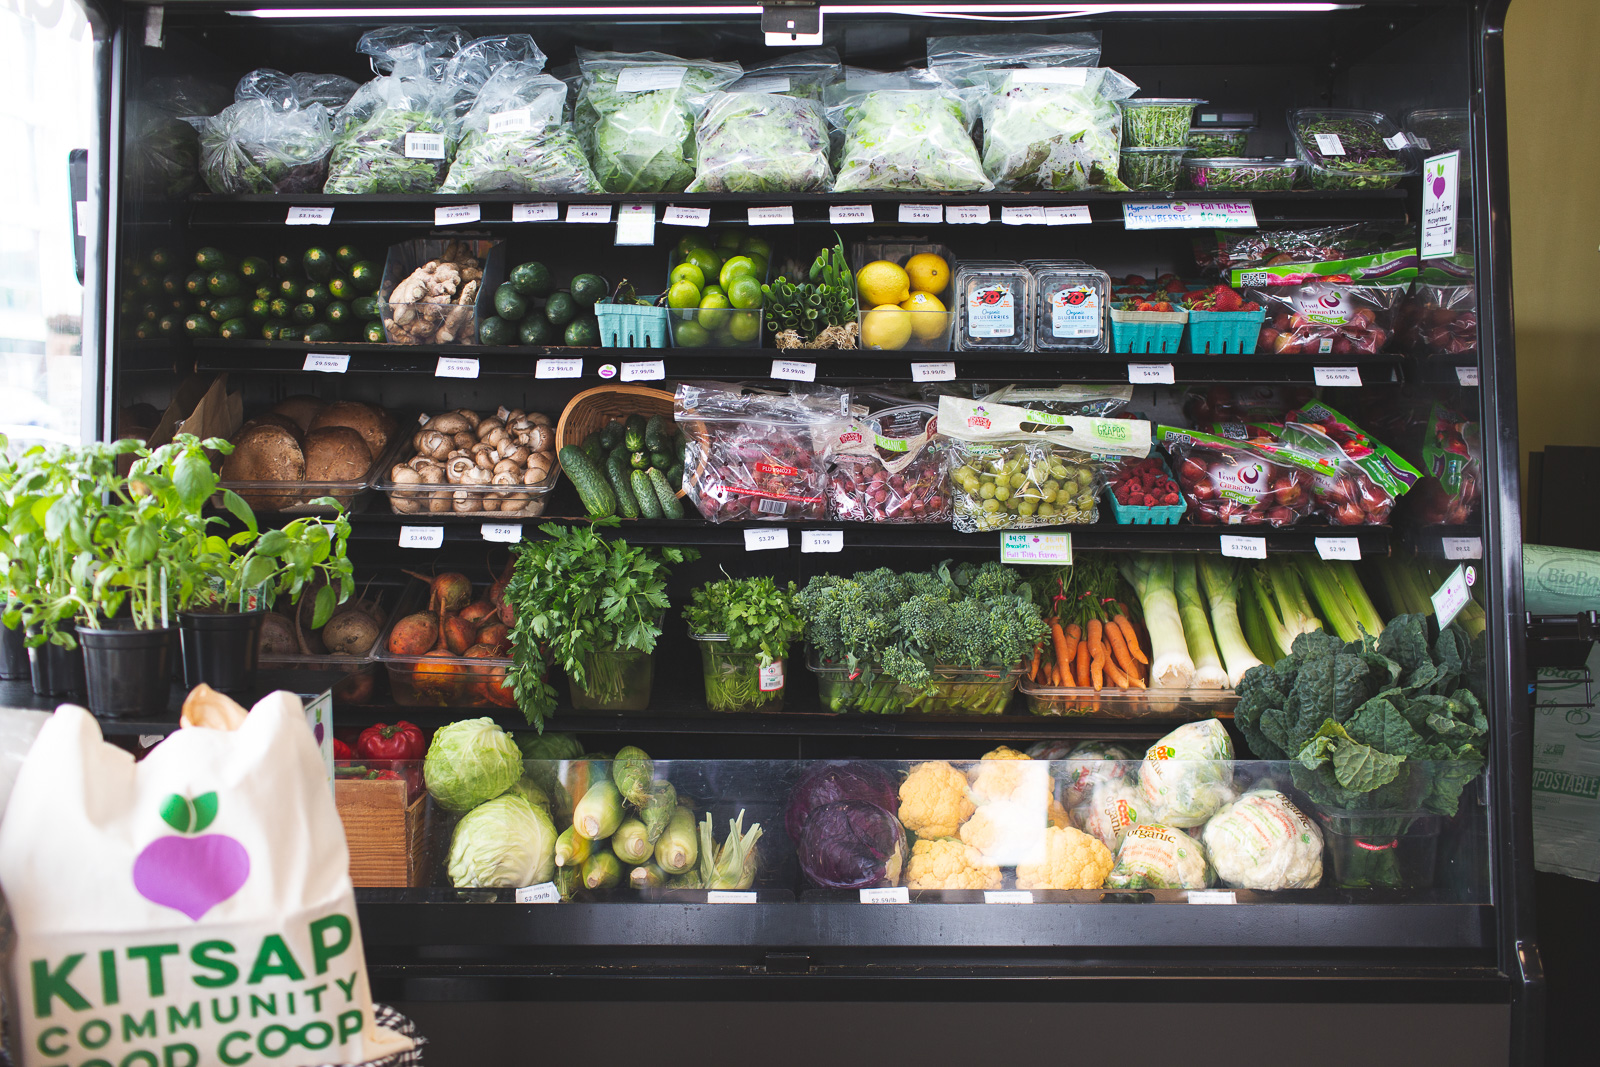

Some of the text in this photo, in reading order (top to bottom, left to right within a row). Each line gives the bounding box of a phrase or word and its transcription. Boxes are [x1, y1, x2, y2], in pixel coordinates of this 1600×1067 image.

[1128, 212, 1192, 224] STRAWBERRIES
[981, 308, 1001, 316] Organic
[1312, 315, 1342, 324] ORGANIC
[1031, 411, 1061, 424] ORGANIC
[1097, 424, 1126, 438] GRAPES
[1038, 551, 1058, 559] Farm
[1547, 568, 1600, 587] BioBa
[1116, 799, 1131, 827] FOXY
[1275, 793, 1311, 830] organic
[1127, 829, 1177, 844] organic
[524, 893, 550, 902] $2.59/lb
[31, 913, 353, 1019] KITSAP
[37, 971, 358, 1058] COMMUNITY
